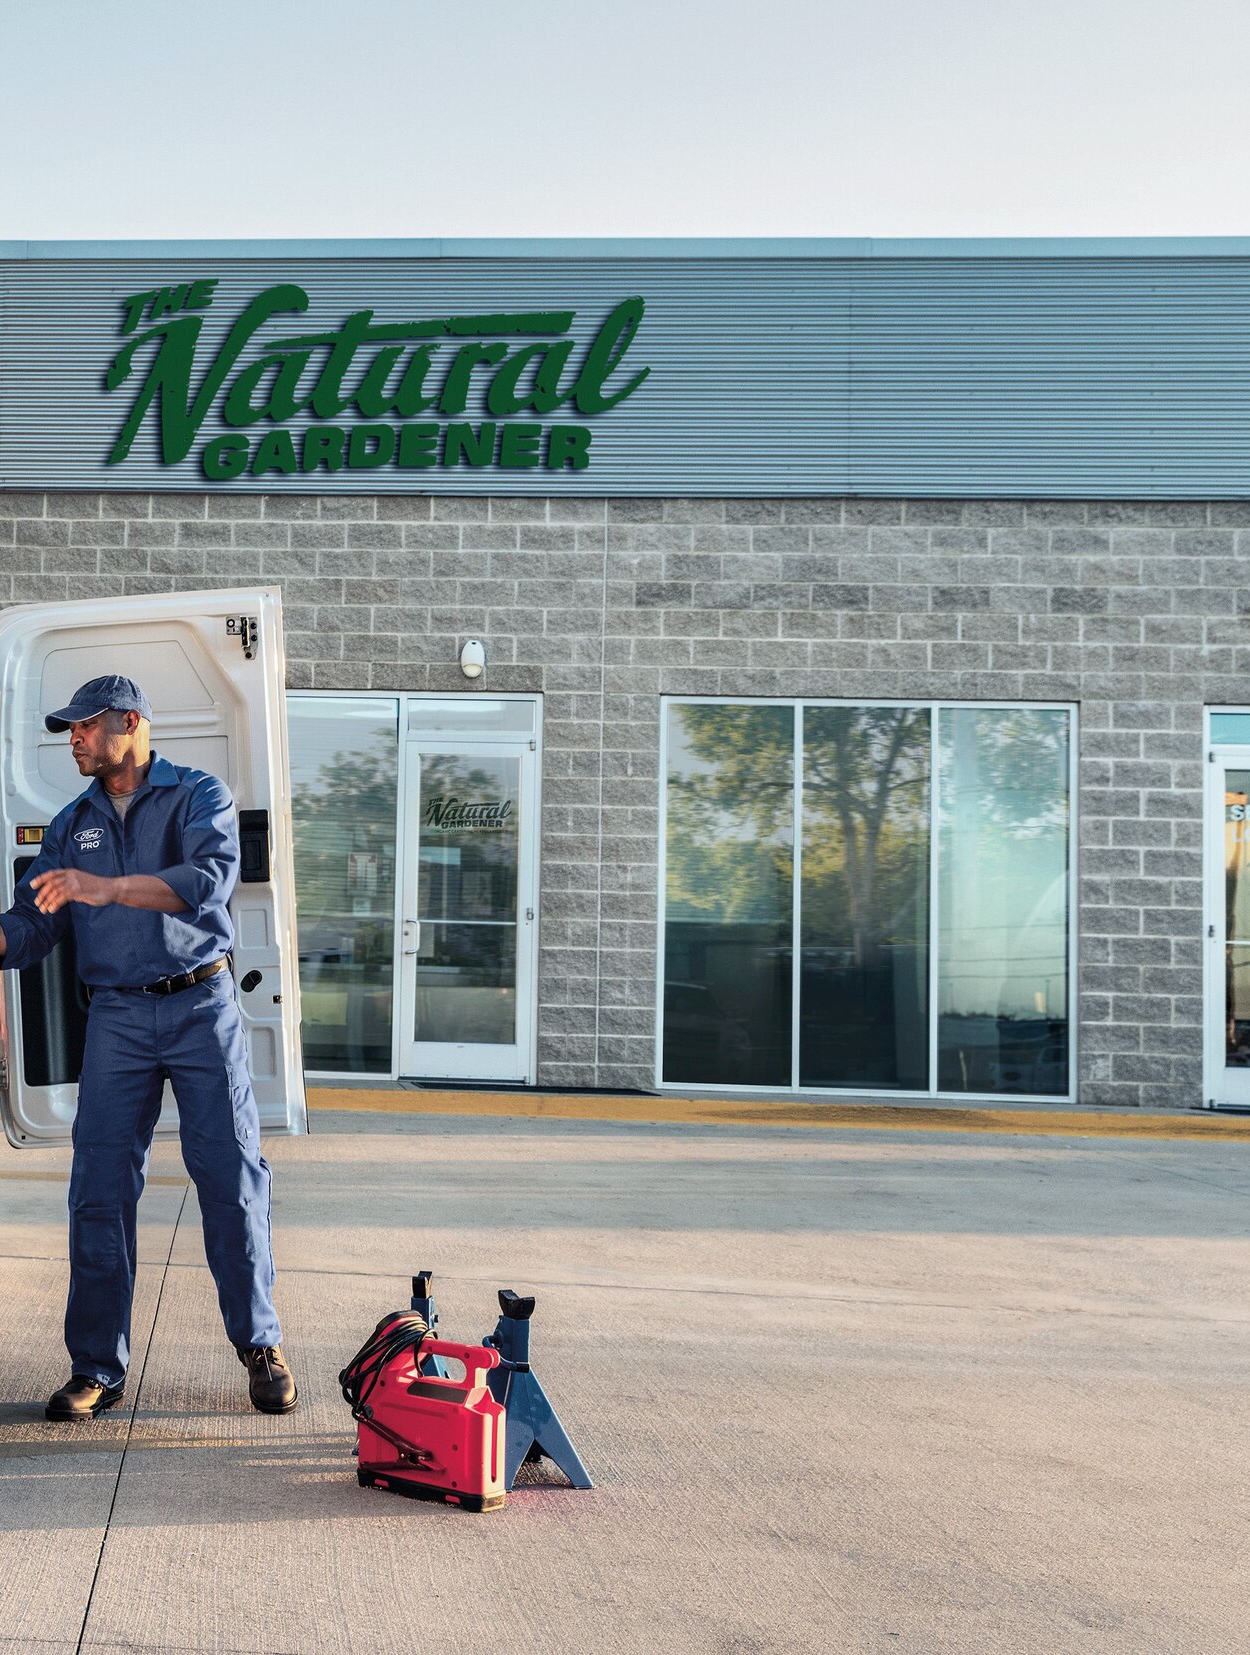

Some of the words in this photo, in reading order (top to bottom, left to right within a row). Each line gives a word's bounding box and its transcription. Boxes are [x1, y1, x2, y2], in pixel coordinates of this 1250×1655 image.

[121, 278, 219, 336] THE
[107, 284, 651, 466] Natural
[203, 422, 593, 480] GARDENER
[426, 798, 512, 827] Natural
[441, 820, 503, 829] GARDENER
